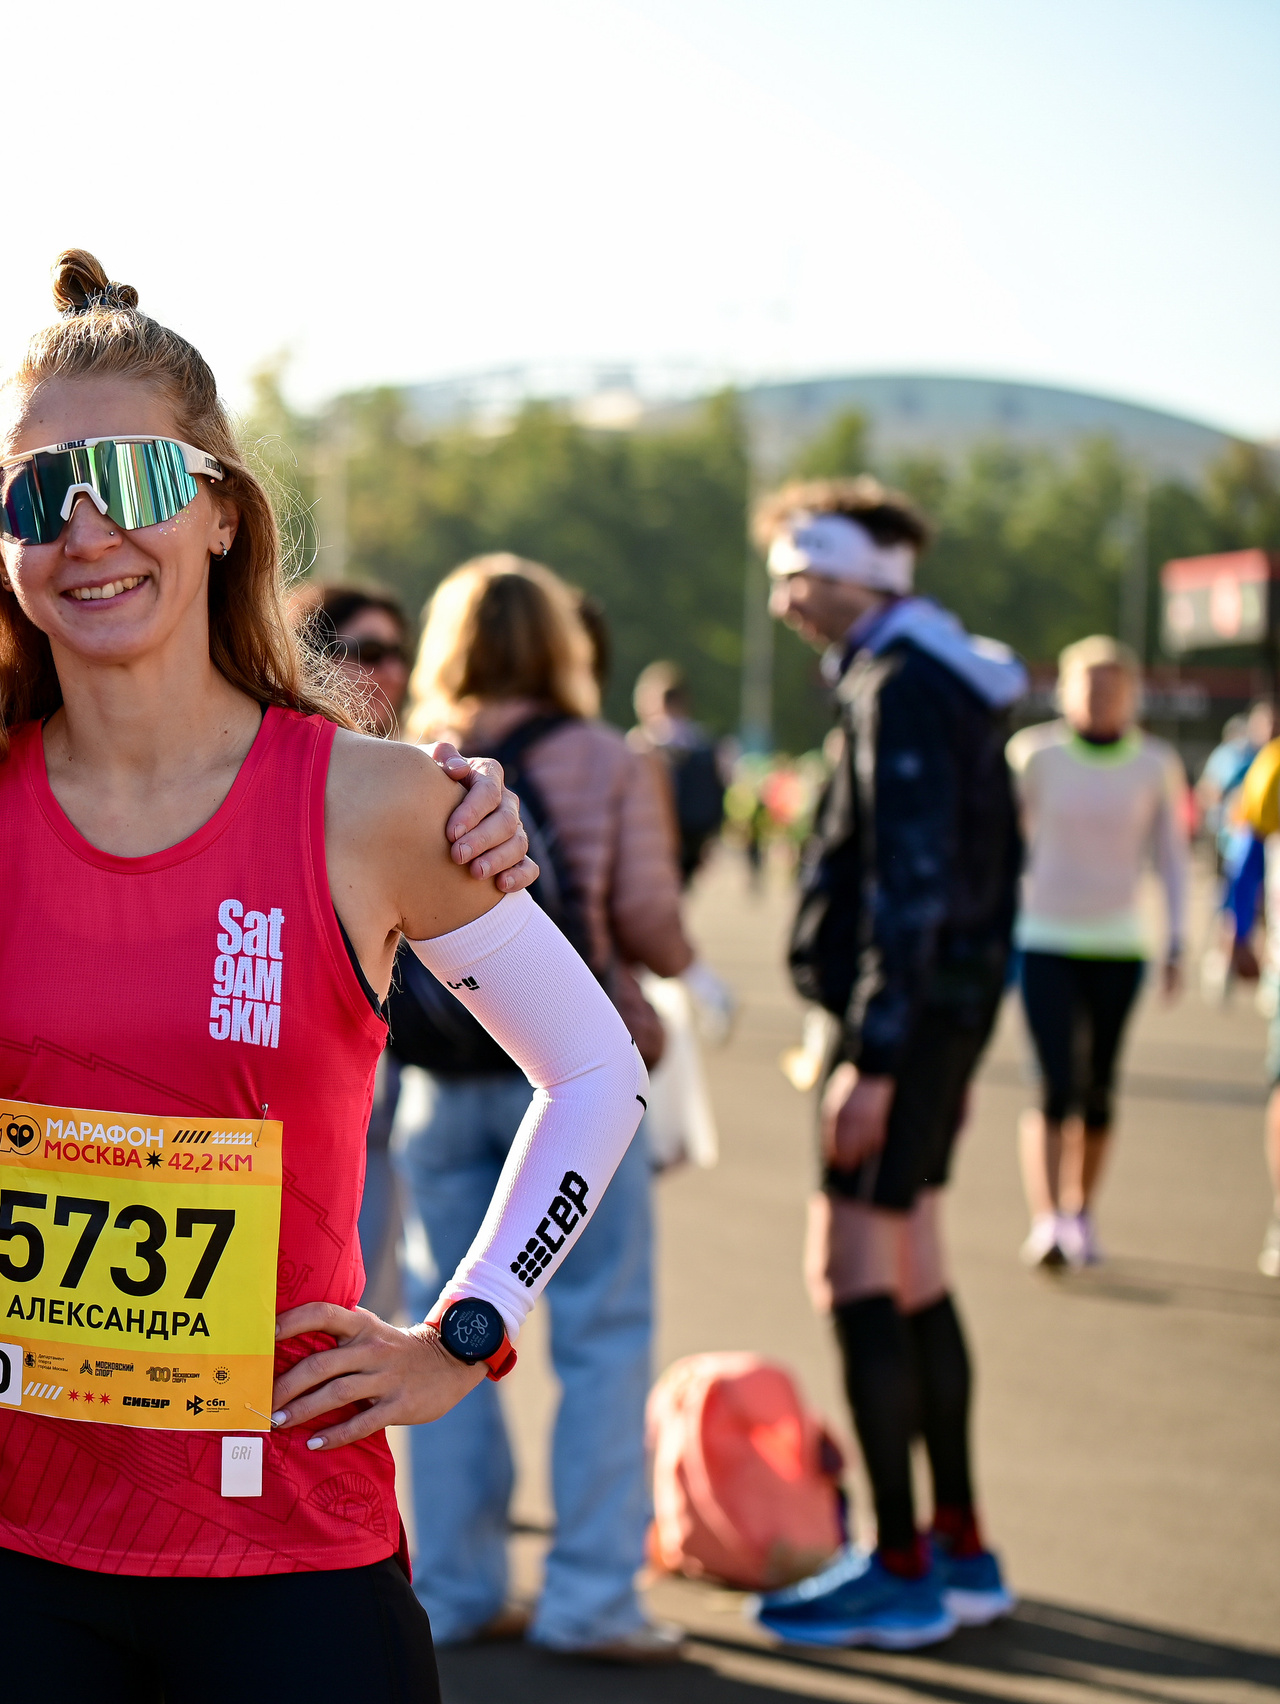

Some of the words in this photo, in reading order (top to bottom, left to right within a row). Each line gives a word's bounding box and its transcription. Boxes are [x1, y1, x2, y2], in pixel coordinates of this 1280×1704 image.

[217, 898, 285, 960] Sat
[213, 954, 283, 1004] 9AM
[209, 996, 281, 1049] 5KM
[45, 1117, 164, 1148] МАРАФОН
[44, 1140, 143, 1168] МОСКВА
[167, 1152, 214, 1173] 42,2
[535, 1170, 589, 1254] cep
[6, 1294, 211, 1341] АЛЕКСАНДРА
[94, 1369, 113, 1378] СПОРТ
[95, 1360, 134, 1372] МОСКОВСКИЙ
[145, 1366, 171, 1382] 100
[122, 1395, 171, 1409] СИБУР
[206, 1398, 226, 1406] сбп
[231, 1445, 252, 1460] GRi
